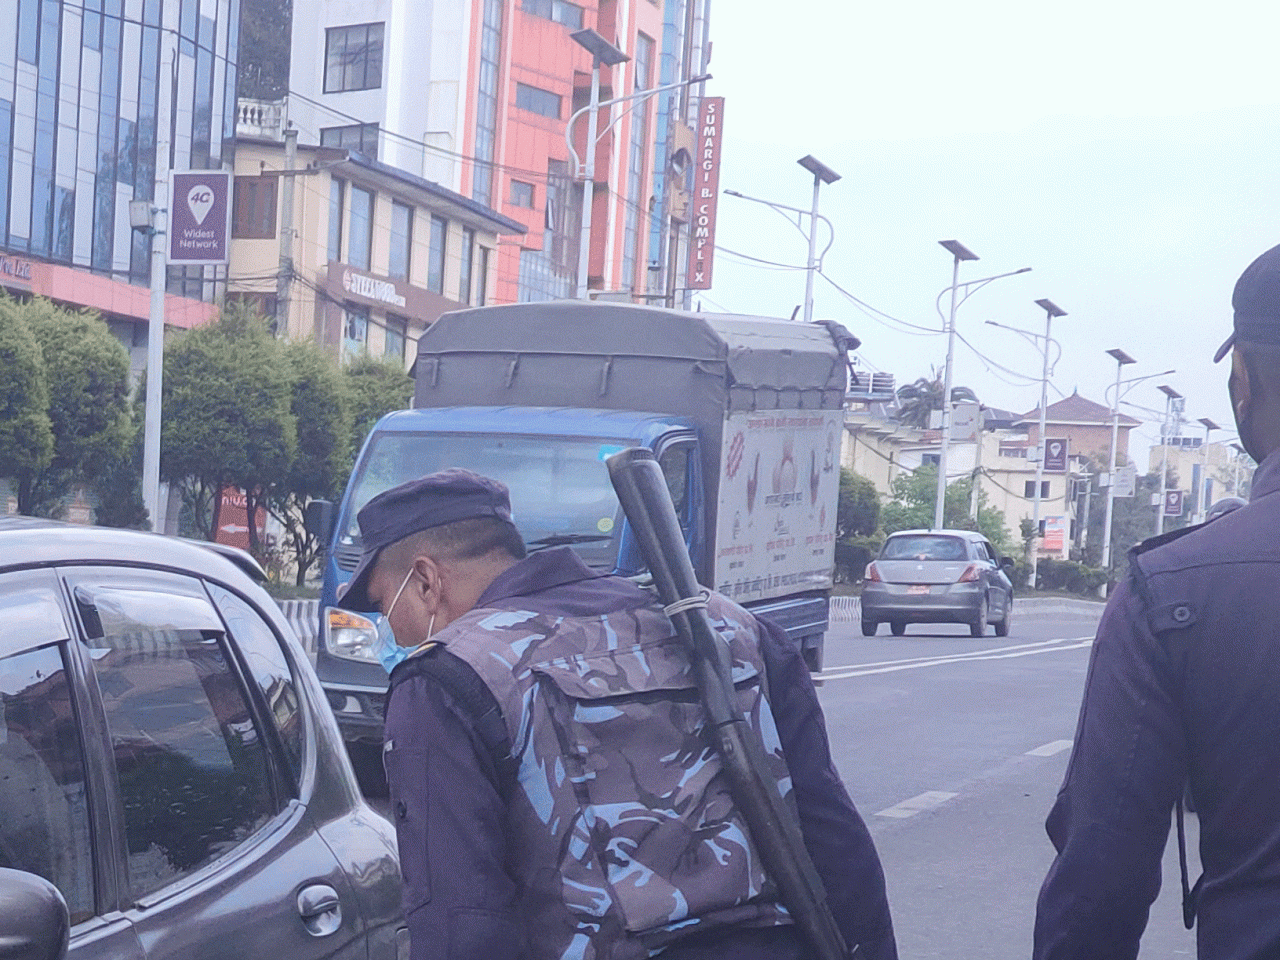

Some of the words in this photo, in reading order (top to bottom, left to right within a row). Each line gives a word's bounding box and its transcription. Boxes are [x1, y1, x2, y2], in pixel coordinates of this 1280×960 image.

[703, 103, 716, 182] SUMARGI
[184, 229, 214, 238] Widest
[180, 240, 218, 249] Network
